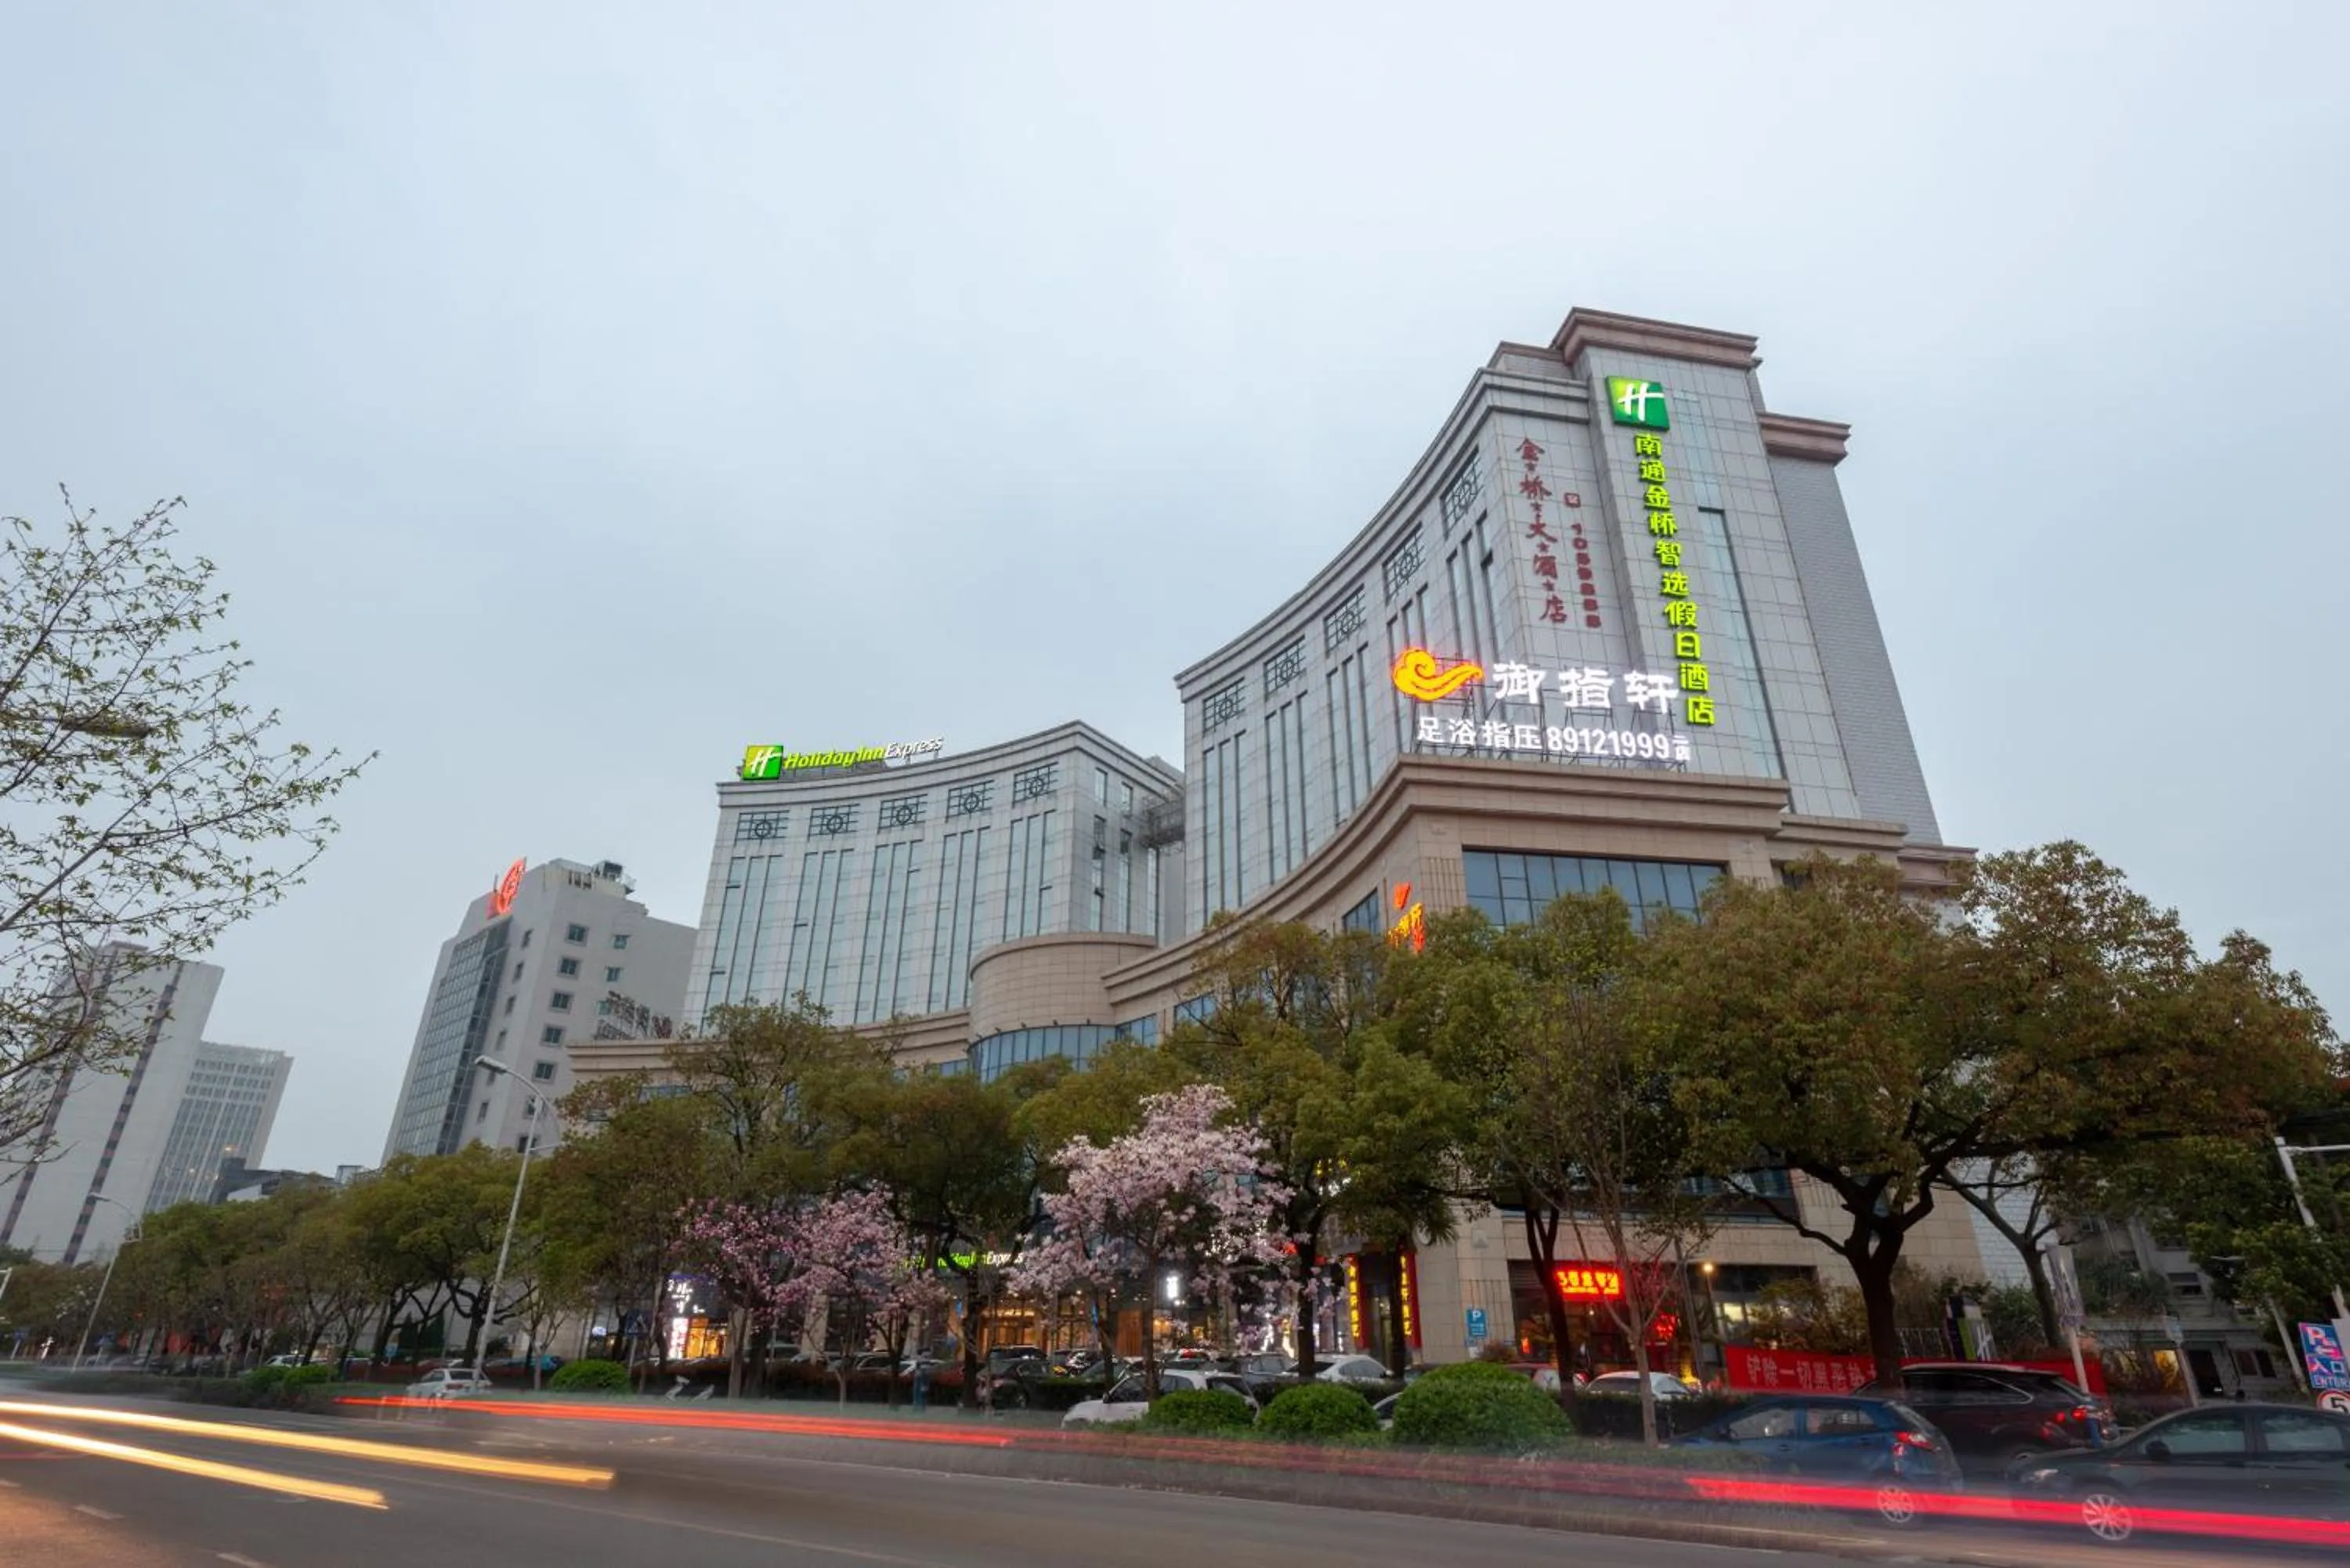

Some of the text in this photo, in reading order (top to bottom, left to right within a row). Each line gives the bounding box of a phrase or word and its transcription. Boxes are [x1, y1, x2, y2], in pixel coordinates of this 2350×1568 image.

[1634, 433, 1716, 725] 南通金桥智选假日酒店
[1492, 660, 1679, 714] 御指轩
[784, 752, 855, 769] Holiday
[885, 737, 944, 758] Express
